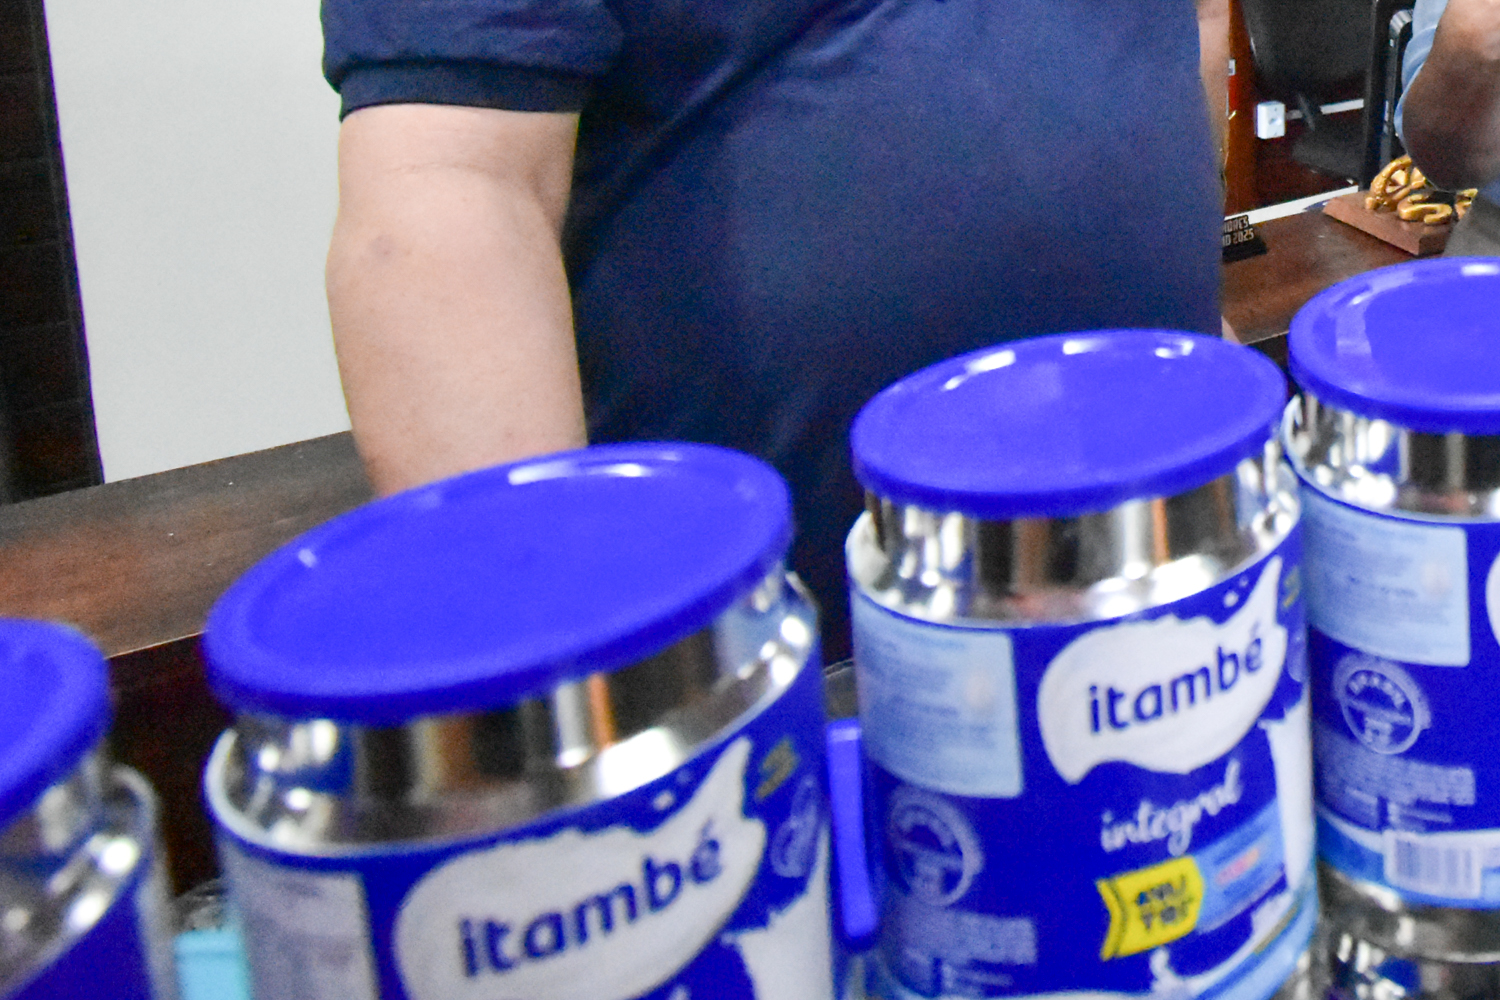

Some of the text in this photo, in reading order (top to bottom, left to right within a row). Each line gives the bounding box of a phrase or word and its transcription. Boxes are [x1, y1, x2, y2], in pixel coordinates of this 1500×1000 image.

[1087, 621, 1264, 736] itambé
[1100, 758, 1242, 857] integral
[457, 816, 722, 978] itambé
